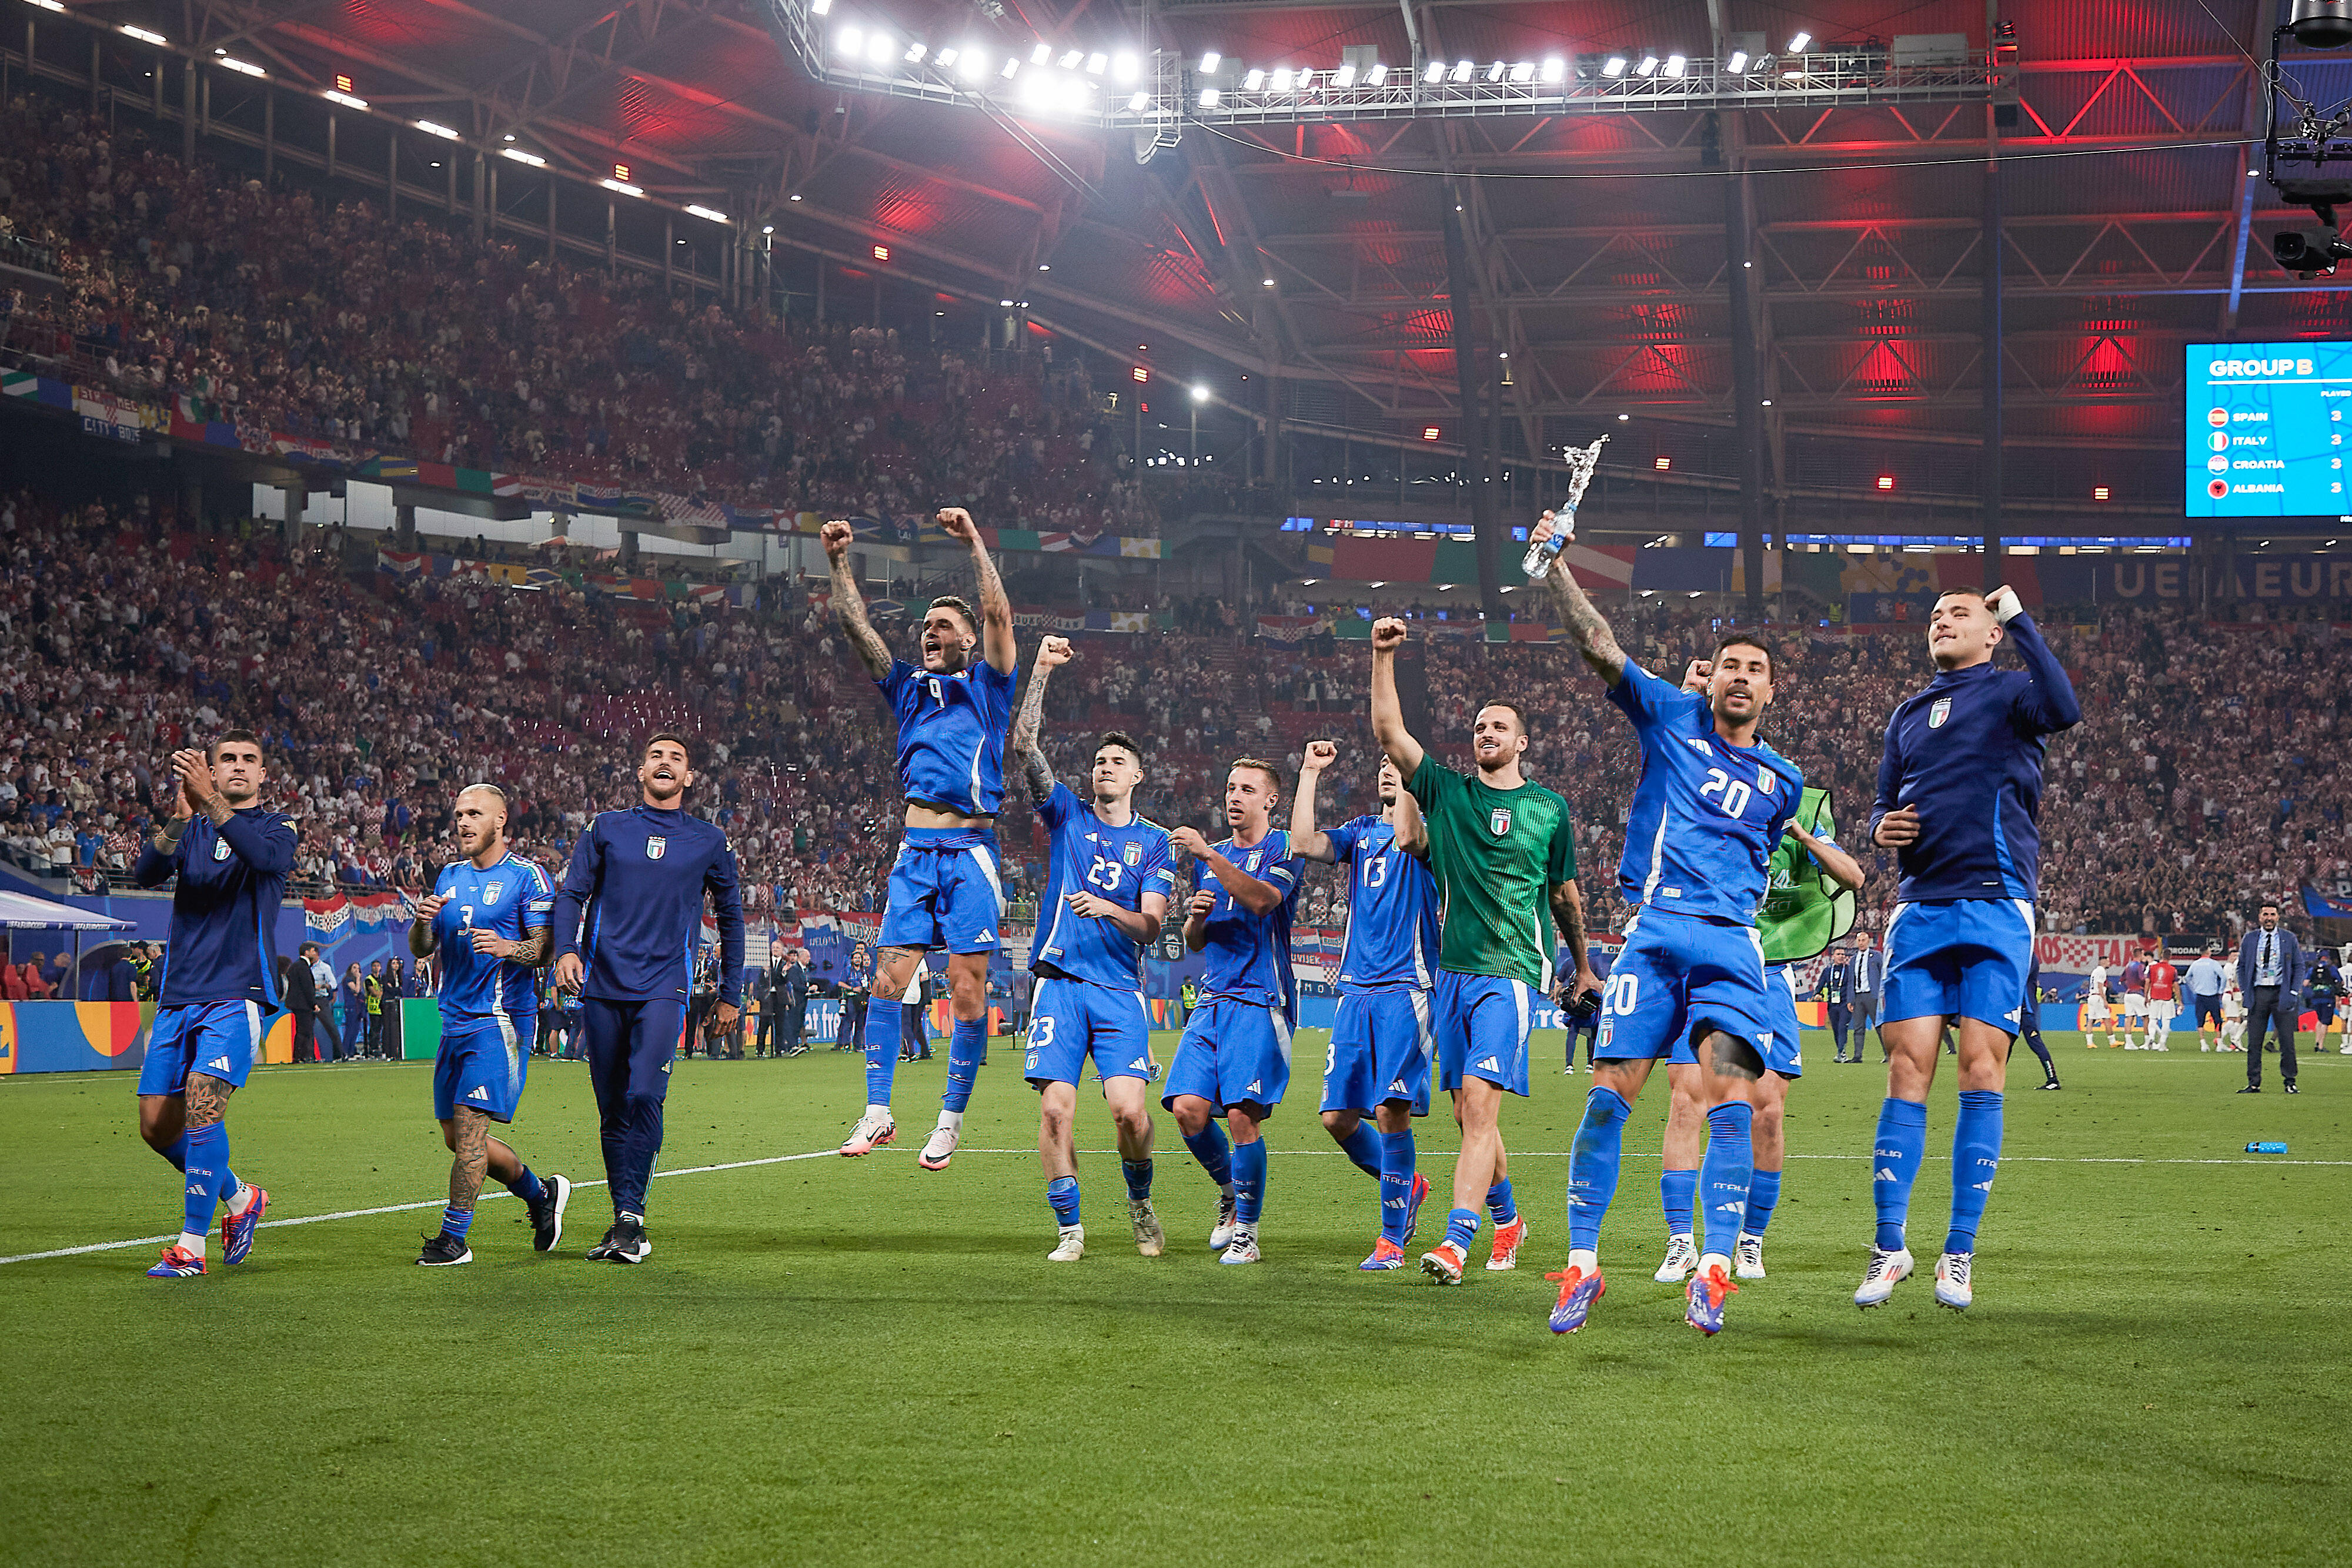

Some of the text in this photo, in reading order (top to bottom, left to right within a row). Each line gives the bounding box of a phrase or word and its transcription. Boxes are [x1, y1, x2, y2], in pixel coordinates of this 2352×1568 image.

[2209, 359, 2313, 376] GROUP B
[2233, 410, 2342, 422] SPAIN 3
[2233, 434, 2342, 445] ITALY 3
[2233, 458, 2342, 469] CROATIA 3
[2233, 482, 2342, 493] ALBANIA 3
[929, 678, 945, 708] 9
[1699, 767, 1752, 820] 20
[1087, 855, 1122, 891] 23
[1364, 857, 1387, 888] 13
[457, 905, 473, 936] 3
[1601, 973, 1639, 1017] 20
[1532, 1009, 1569, 1029] re
[1025, 1016, 1055, 1049] 23
[1382, 1174, 1411, 1186] ITALIA
